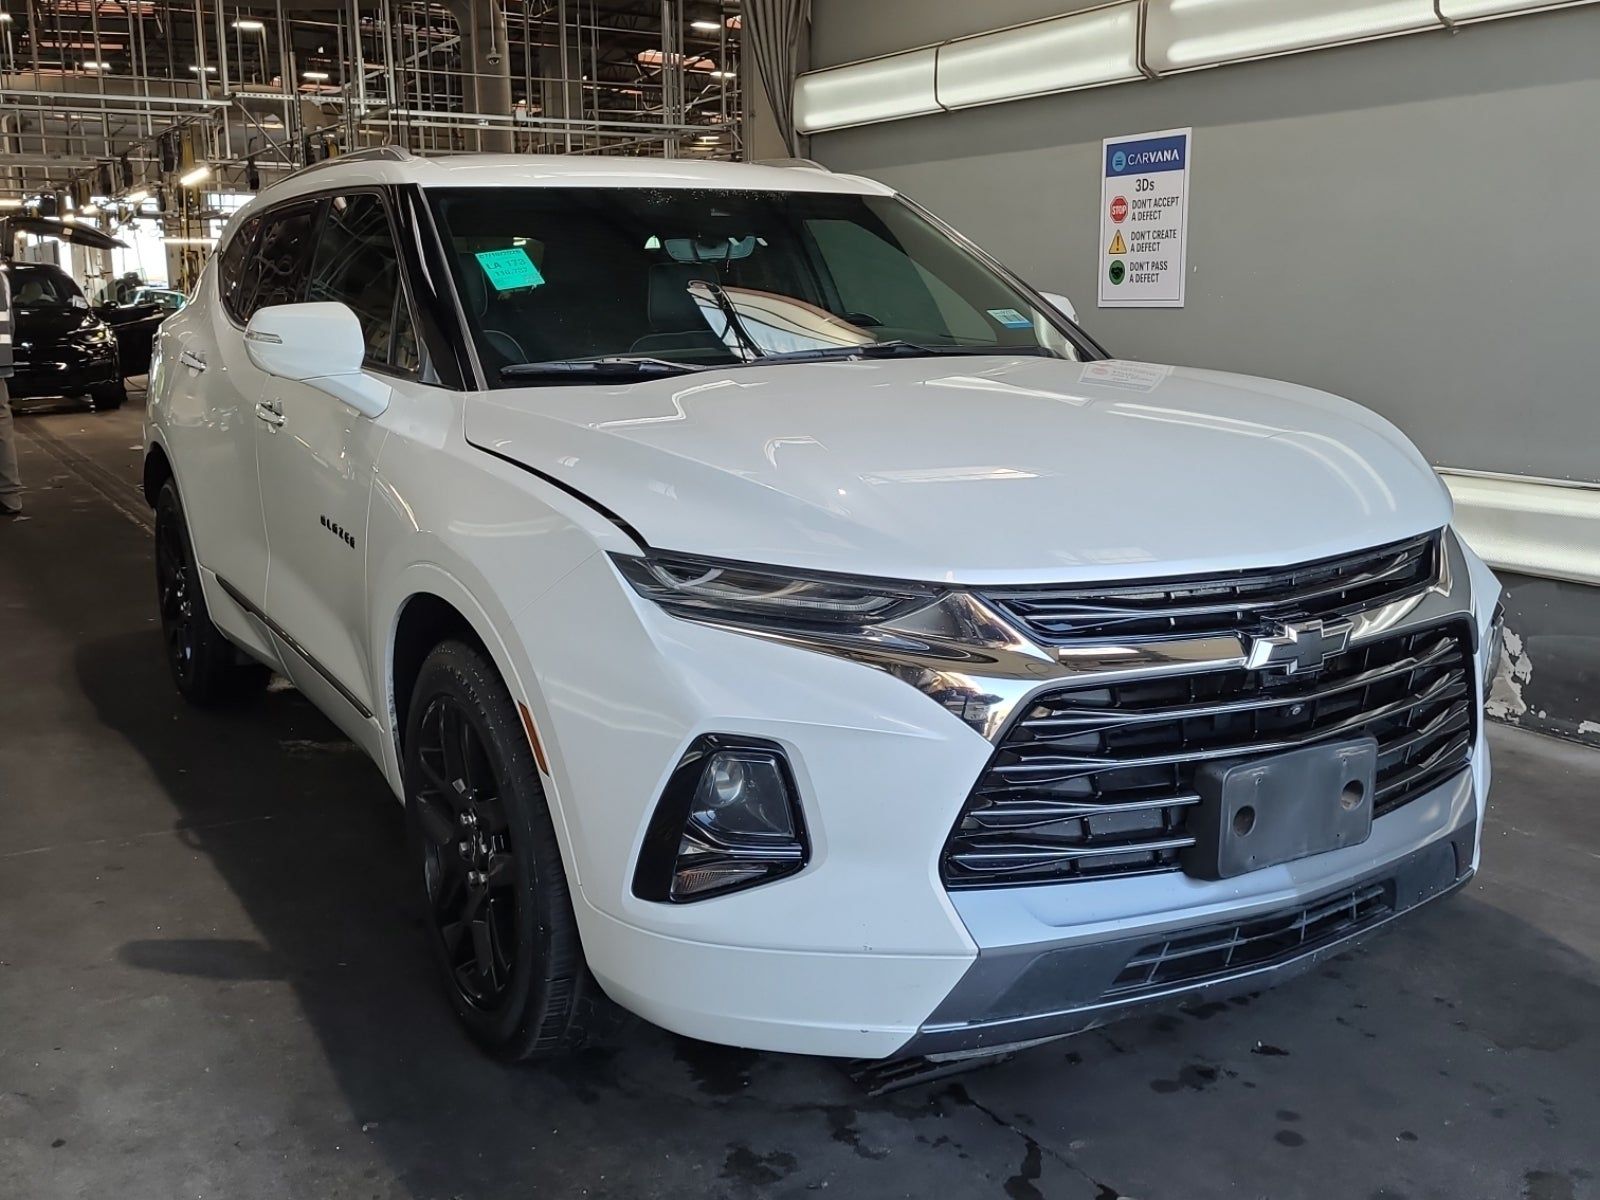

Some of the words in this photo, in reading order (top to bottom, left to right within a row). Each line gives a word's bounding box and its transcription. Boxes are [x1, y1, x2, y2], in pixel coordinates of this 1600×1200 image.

[1128, 149, 1179, 165] CARVANA
[1135, 178, 1155, 192] 3Ds
[1131, 198, 1152, 209] DON'T
[1153, 196, 1179, 207] ACCEPT
[1111, 205, 1127, 215] STOP
[1131, 212, 1136, 221] A
[1137, 210, 1162, 221] DEFECT
[1130, 230, 1151, 241] DON'T
[1152, 229, 1177, 239] CREATE
[1130, 243, 1135, 252] A
[1136, 242, 1160, 252] DEFECT
[1129, 261, 1150, 271] DON'T
[1151, 261, 1168, 271] PASS
[1129, 274, 1134, 283] A
[1135, 272, 1160, 283] DEFECT
[320, 514, 355, 549] BLAZER
